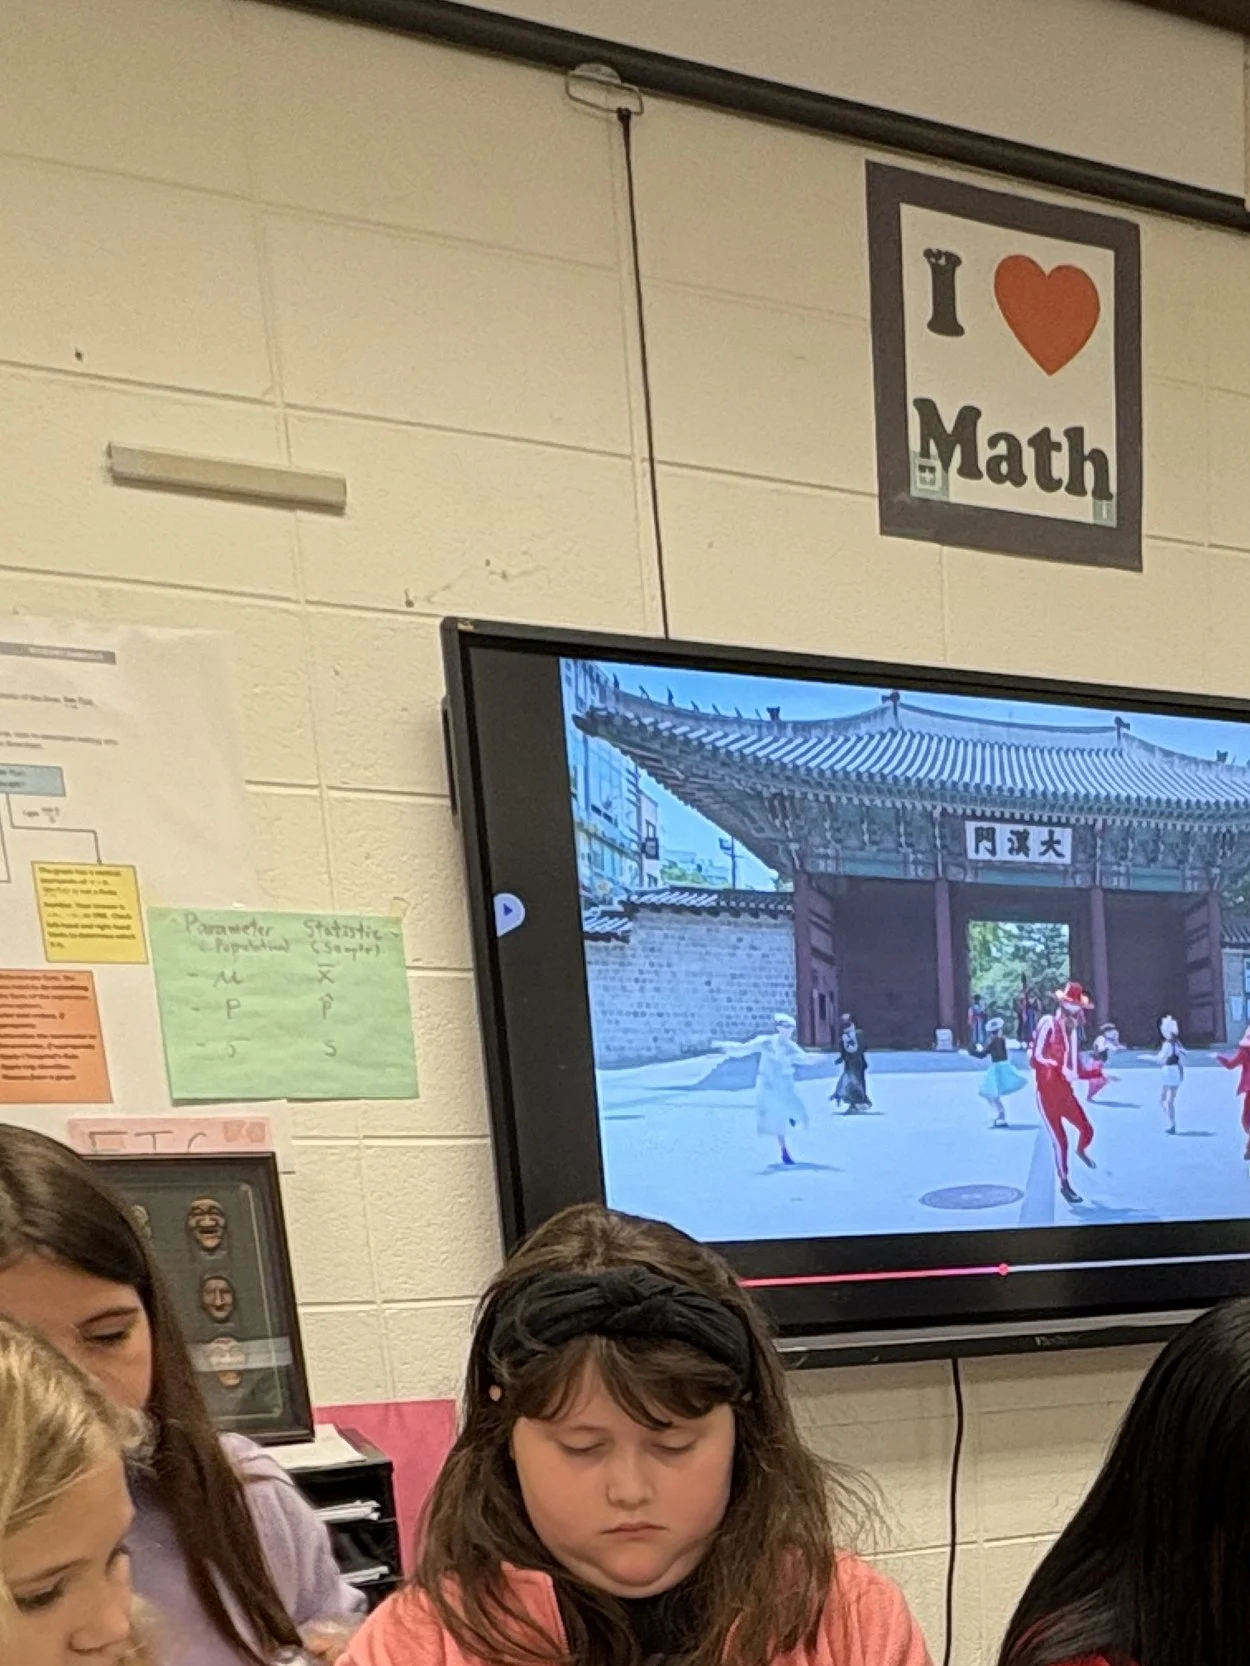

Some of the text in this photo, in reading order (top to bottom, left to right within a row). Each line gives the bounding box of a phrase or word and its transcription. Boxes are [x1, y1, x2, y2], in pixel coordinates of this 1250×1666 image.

[923, 248, 965, 337] I
[912, 397, 1114, 502] Math
[184, 912, 384, 940] Parameter Statistic
